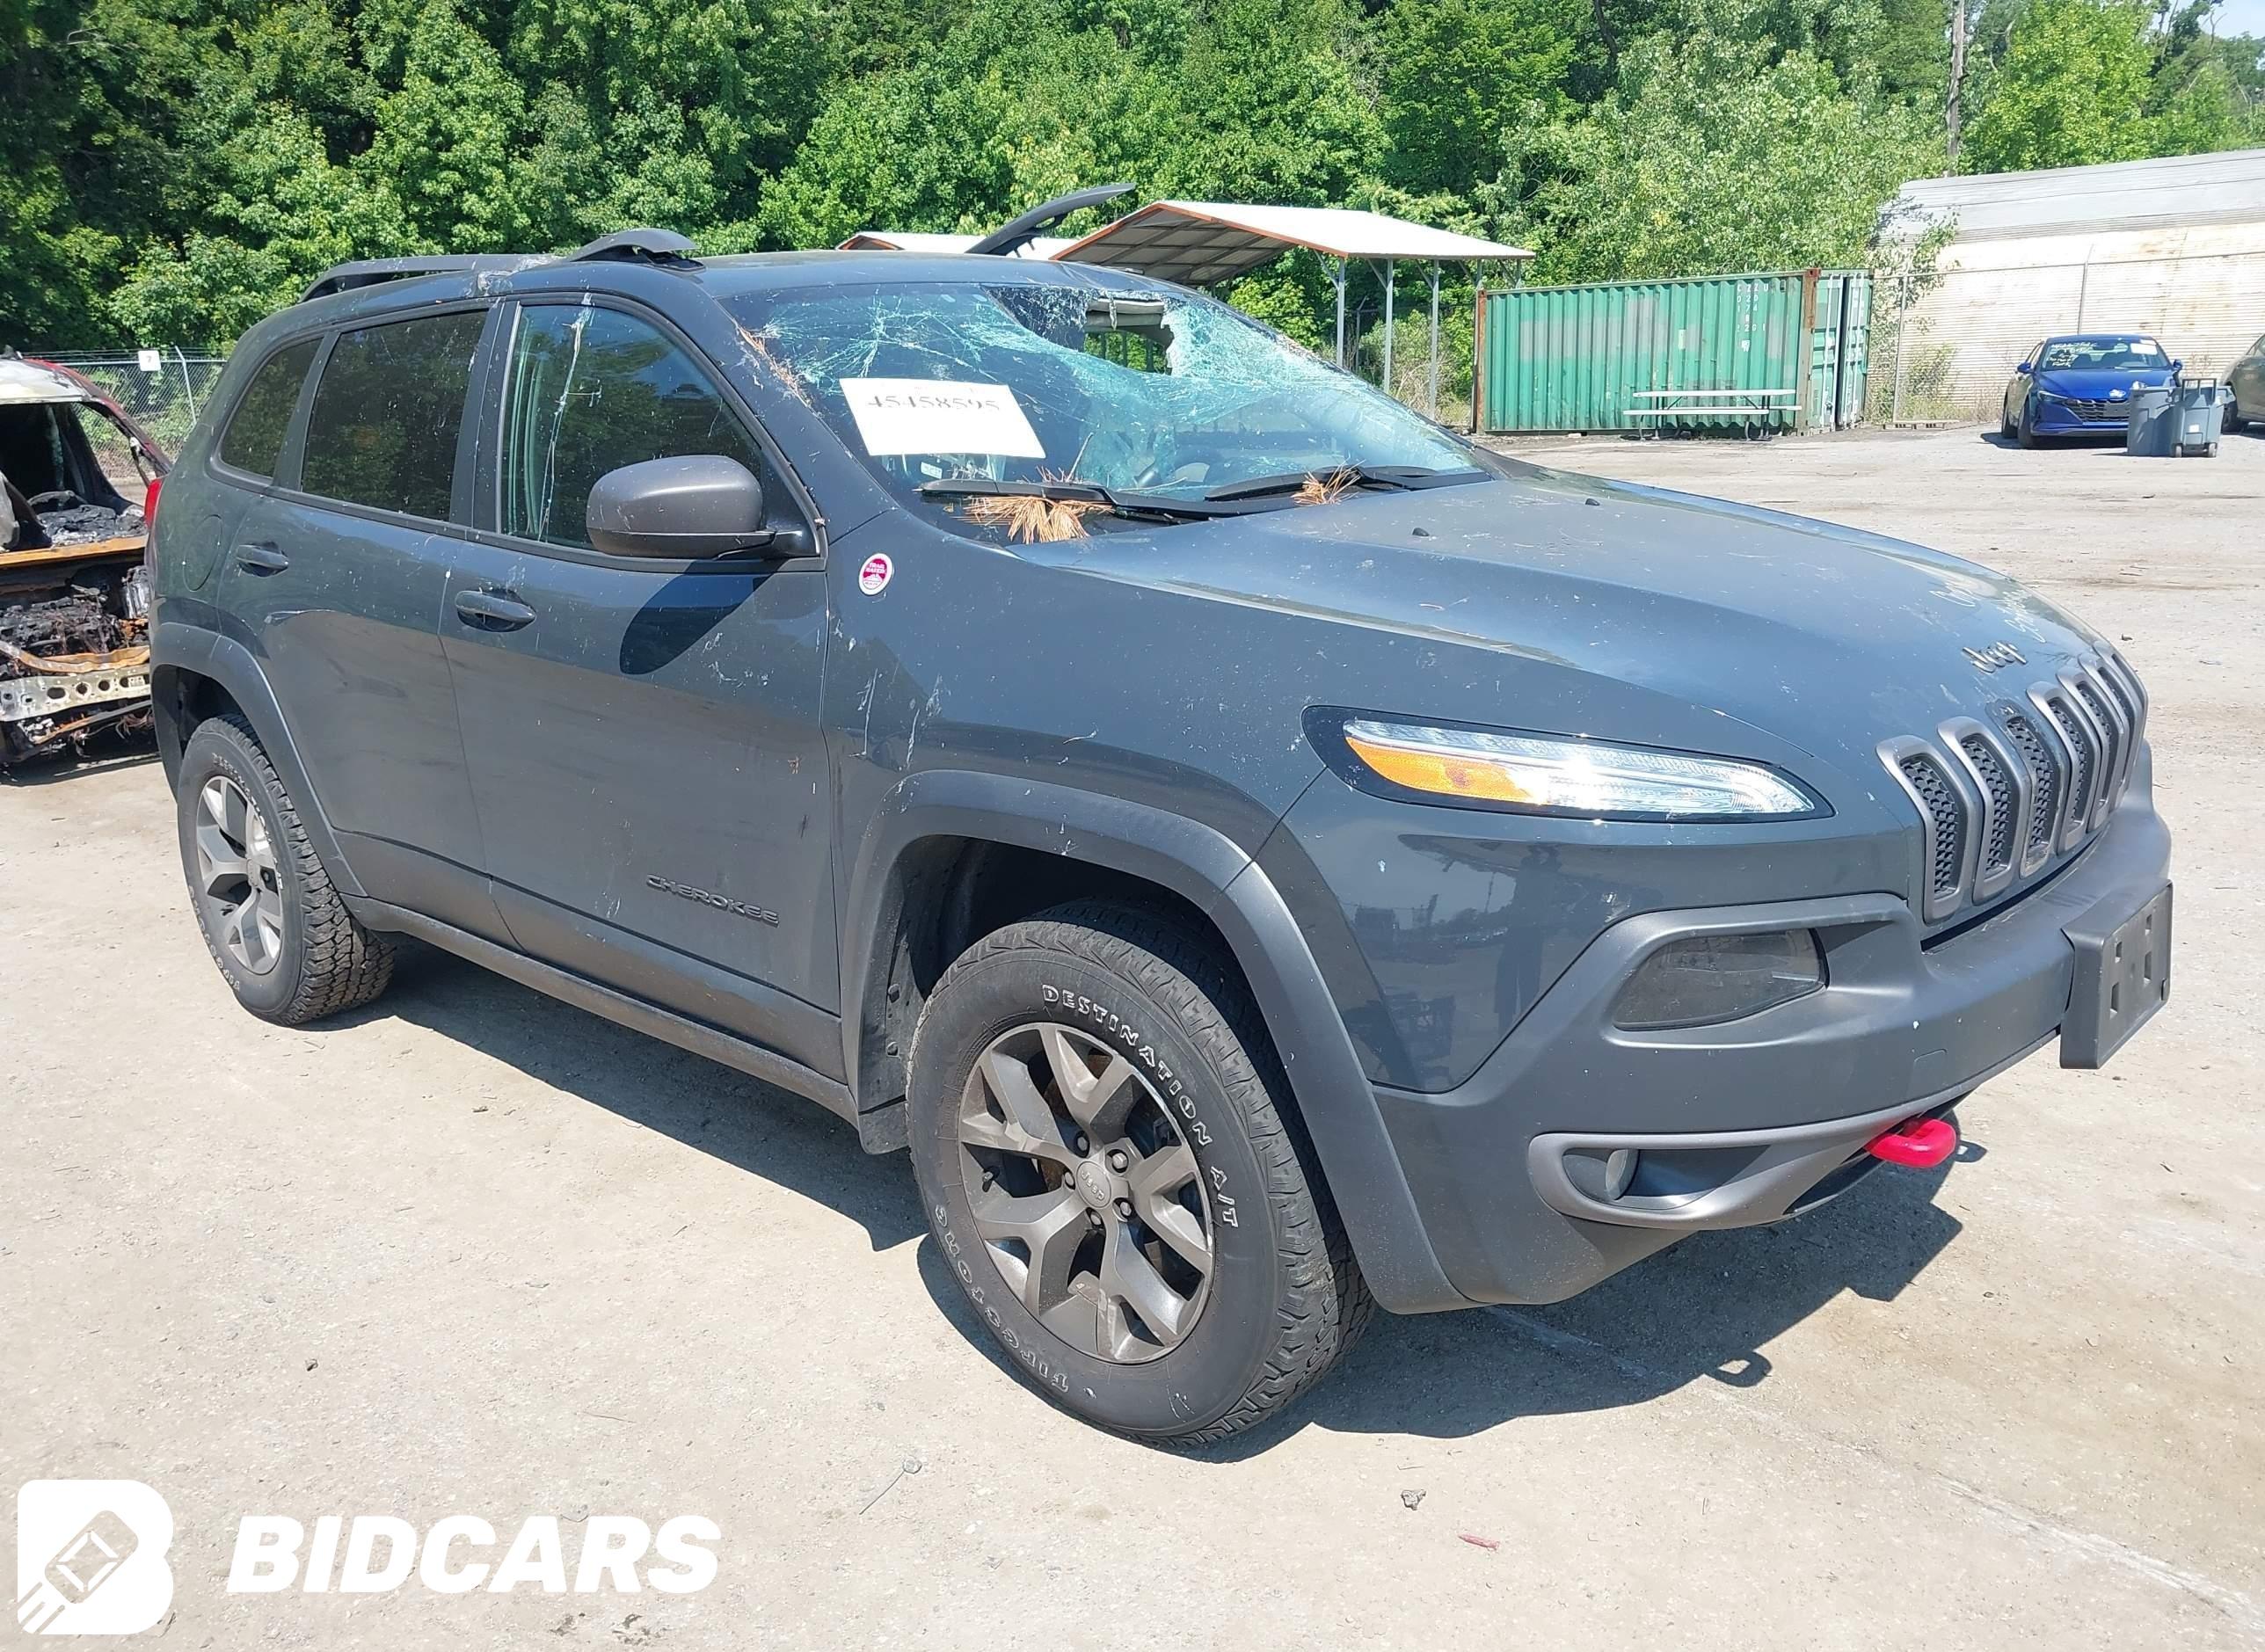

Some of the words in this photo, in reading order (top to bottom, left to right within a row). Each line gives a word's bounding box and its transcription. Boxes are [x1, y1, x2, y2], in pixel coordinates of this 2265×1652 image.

[646, 874, 780, 928] CHEROKEE
[1042, 984, 1213, 1146] DESTINATION
[1210, 1166, 1239, 1227] A/T
